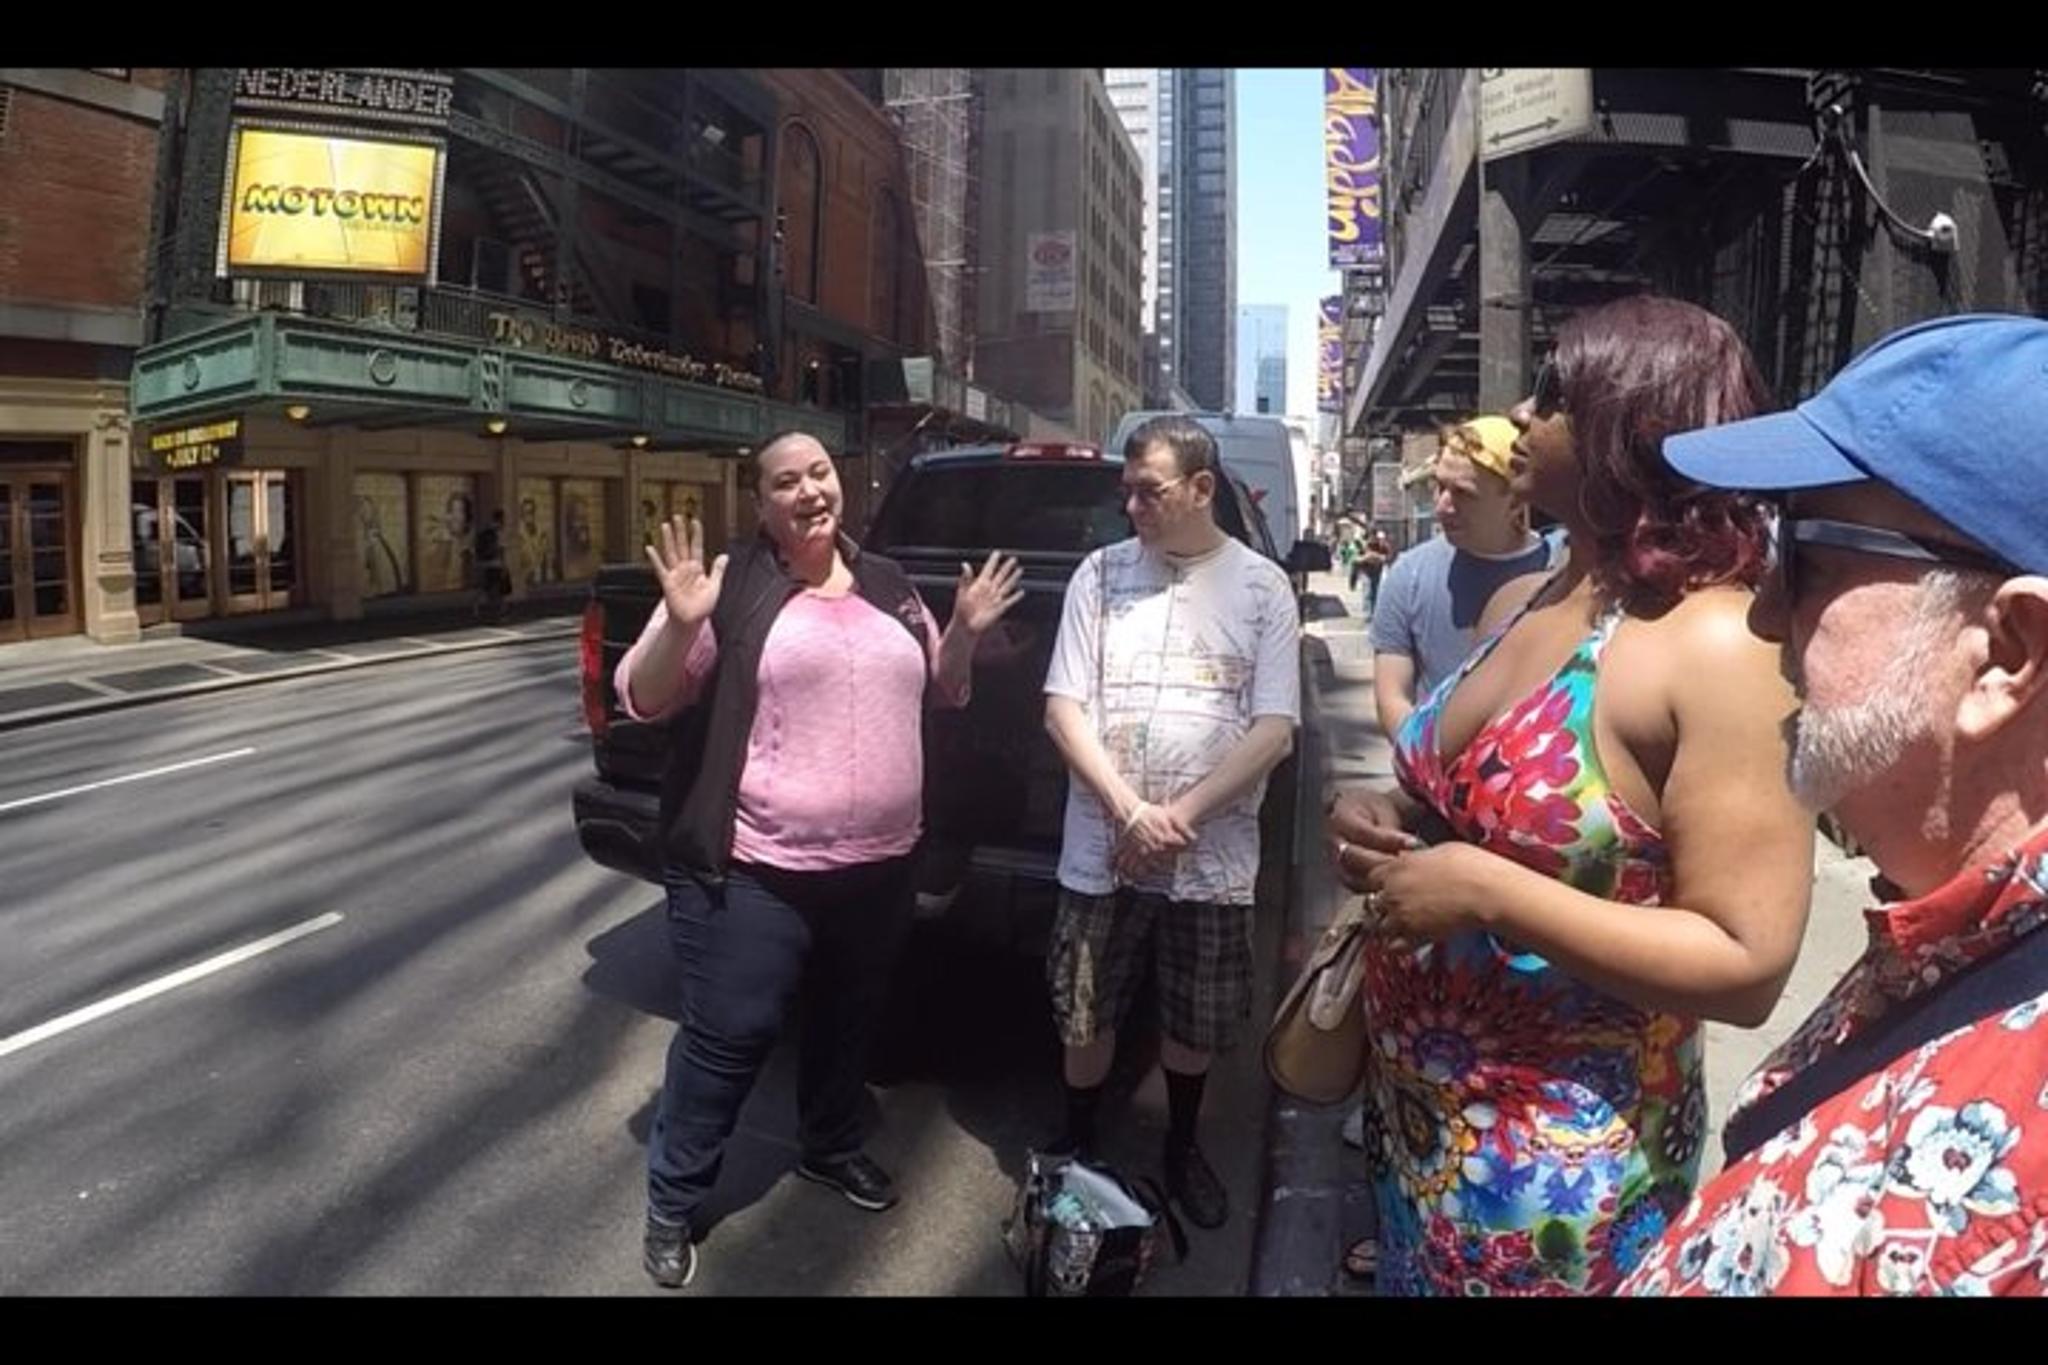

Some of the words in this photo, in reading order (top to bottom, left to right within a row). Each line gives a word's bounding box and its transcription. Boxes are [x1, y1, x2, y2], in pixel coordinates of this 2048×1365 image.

[235, 67, 453, 115] NEDERLANDER
[1326, 68, 1379, 242] Aladdin
[242, 184, 424, 223] MOTOWN
